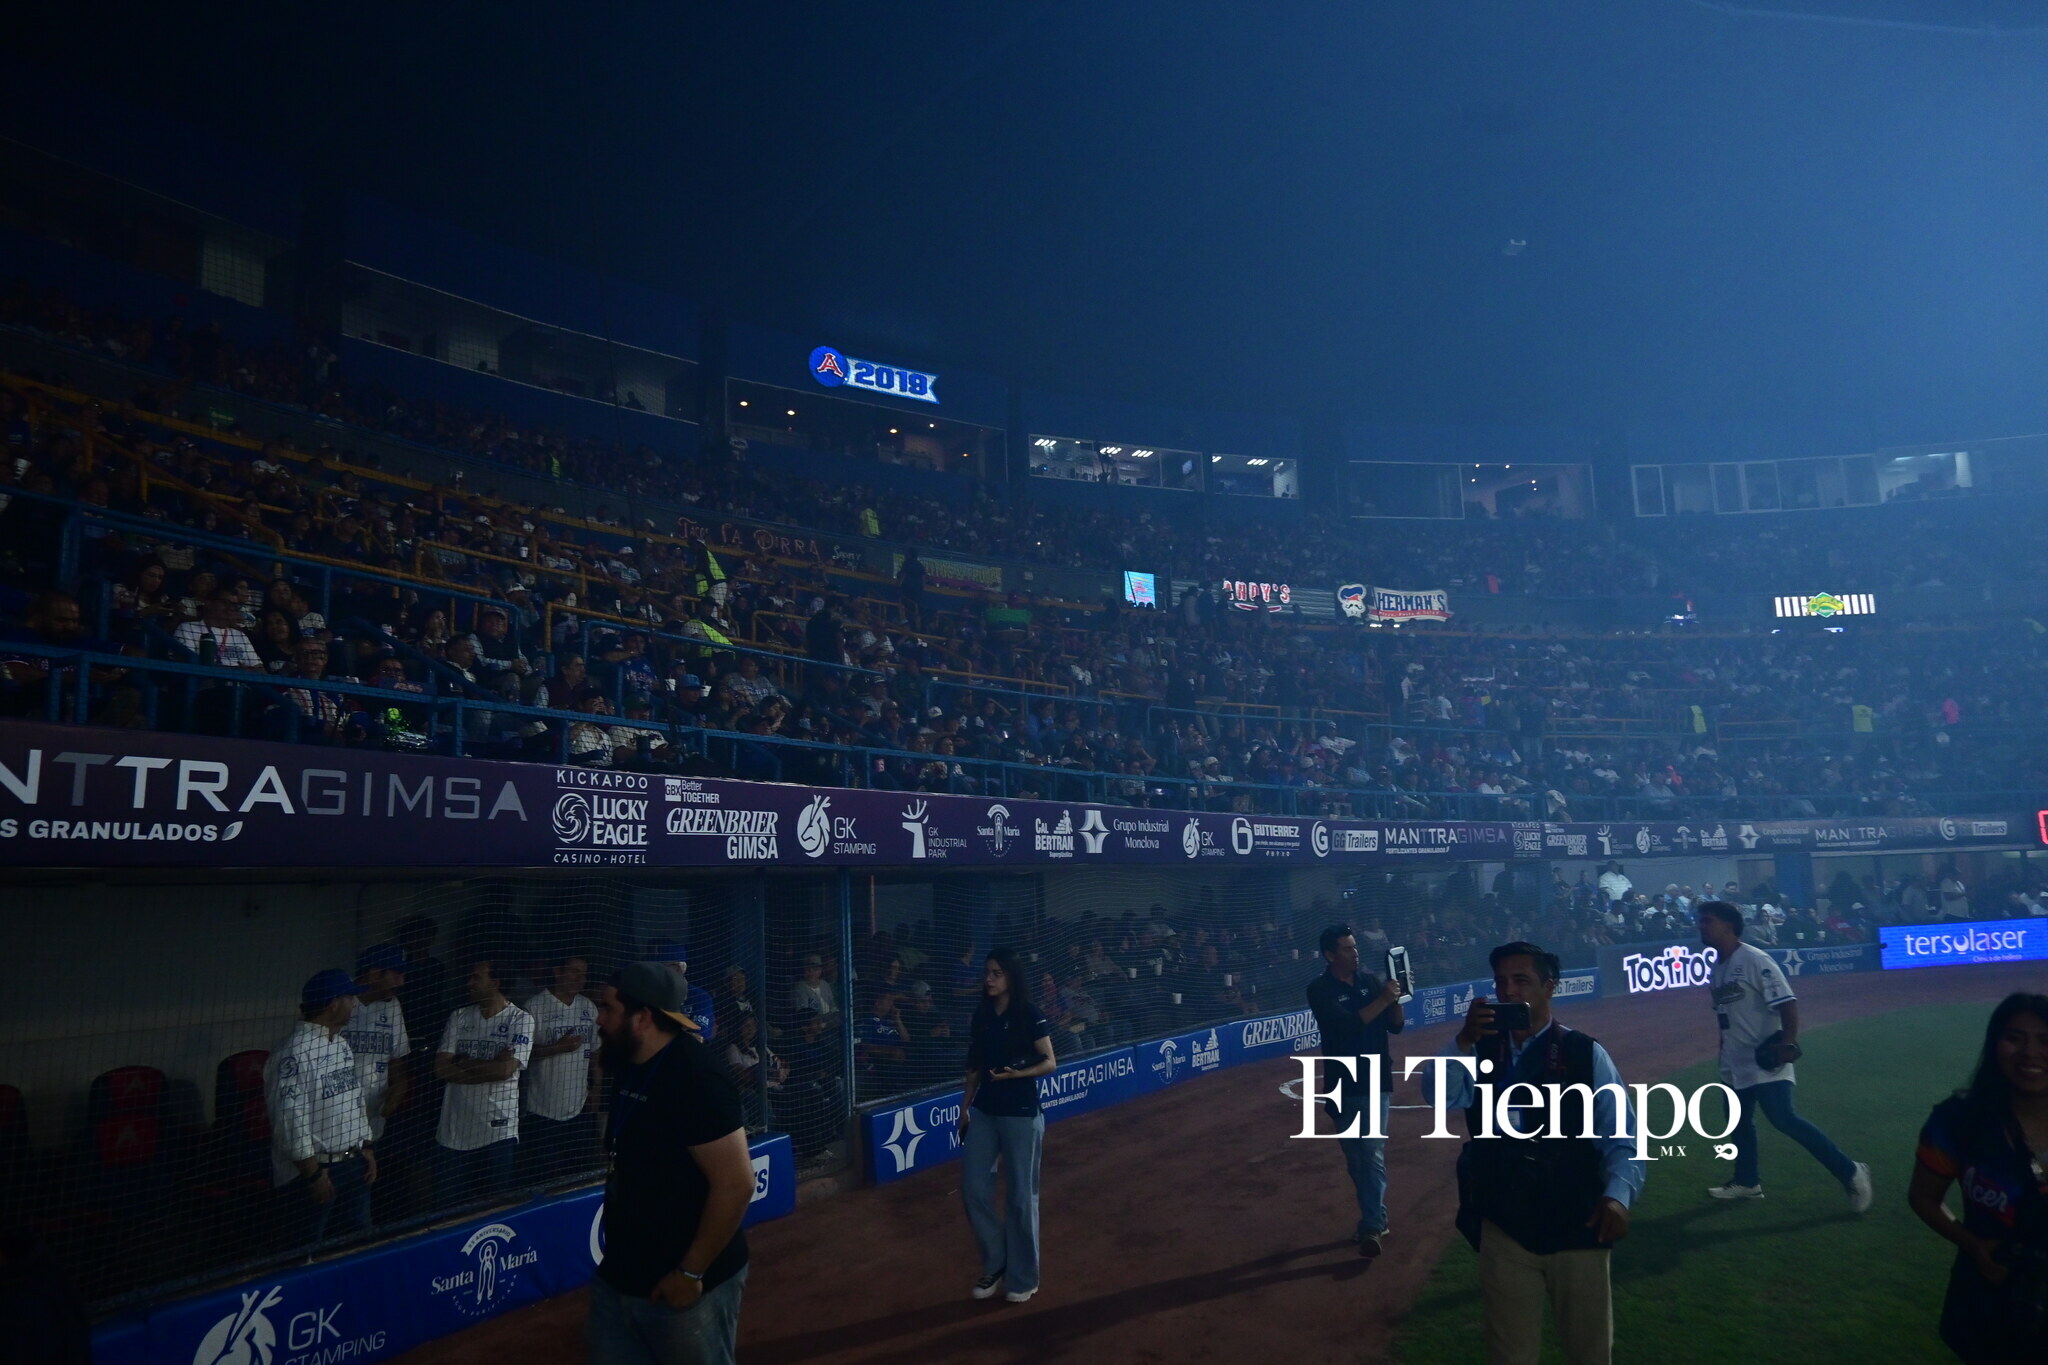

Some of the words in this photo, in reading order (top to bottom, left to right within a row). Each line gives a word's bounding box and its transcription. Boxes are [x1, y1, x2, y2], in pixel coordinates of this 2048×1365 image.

[854, 362, 928, 396] 2018
[1377, 592, 1446, 611] HERMAN'S
[556, 770, 648, 789] KICKAPOO
[682, 779, 703, 791] Better
[665, 783, 681, 797] GBX
[682, 791, 720, 804] TOGETHER
[592, 795, 648, 820] LUCKY
[666, 807, 779, 834] GREENBRIER
[834, 817, 857, 839] GK
[1113, 818, 1137, 834] Grupo
[1138, 819, 1169, 833] Industrial
[28, 819, 218, 842] GRANULADOS
[592, 821, 648, 845] EAGLE
[928, 827, 938, 836] GK
[977, 825, 994, 836] Santa
[1201, 832, 1214, 846] GK
[1254, 824, 1300, 838] GUTIERREZ
[727, 836, 779, 860] GIMSA
[833, 842, 877, 855] STAMPING
[928, 838, 967, 848] INDUSTRIAL
[1035, 835, 1074, 850] BERTRAN
[1125, 836, 1159, 849] Monclova
[1333, 832, 1345, 847] GG
[1347, 832, 1377, 848] Trailers
[553, 853, 601, 864] CASINO
[610, 854, 646, 864] HOTEL
[928, 848, 947, 858] PARK
[1201, 848, 1225, 856] STAMPING
[1905, 928, 2027, 955] tersolaser
[1565, 980, 1593, 993] Trailers
[1294, 1032, 1322, 1052] GIMSA
[1192, 1049, 1220, 1068] BERTRAN
[1036, 1056, 1135, 1099] ANTTRAGIMSA
[930, 1104, 961, 1127] Grup
[430, 1270, 474, 1295] Santa
[499, 1246, 538, 1273] María
[288, 1302, 343, 1351] GK
[284, 1331, 386, 1365] AMPING
